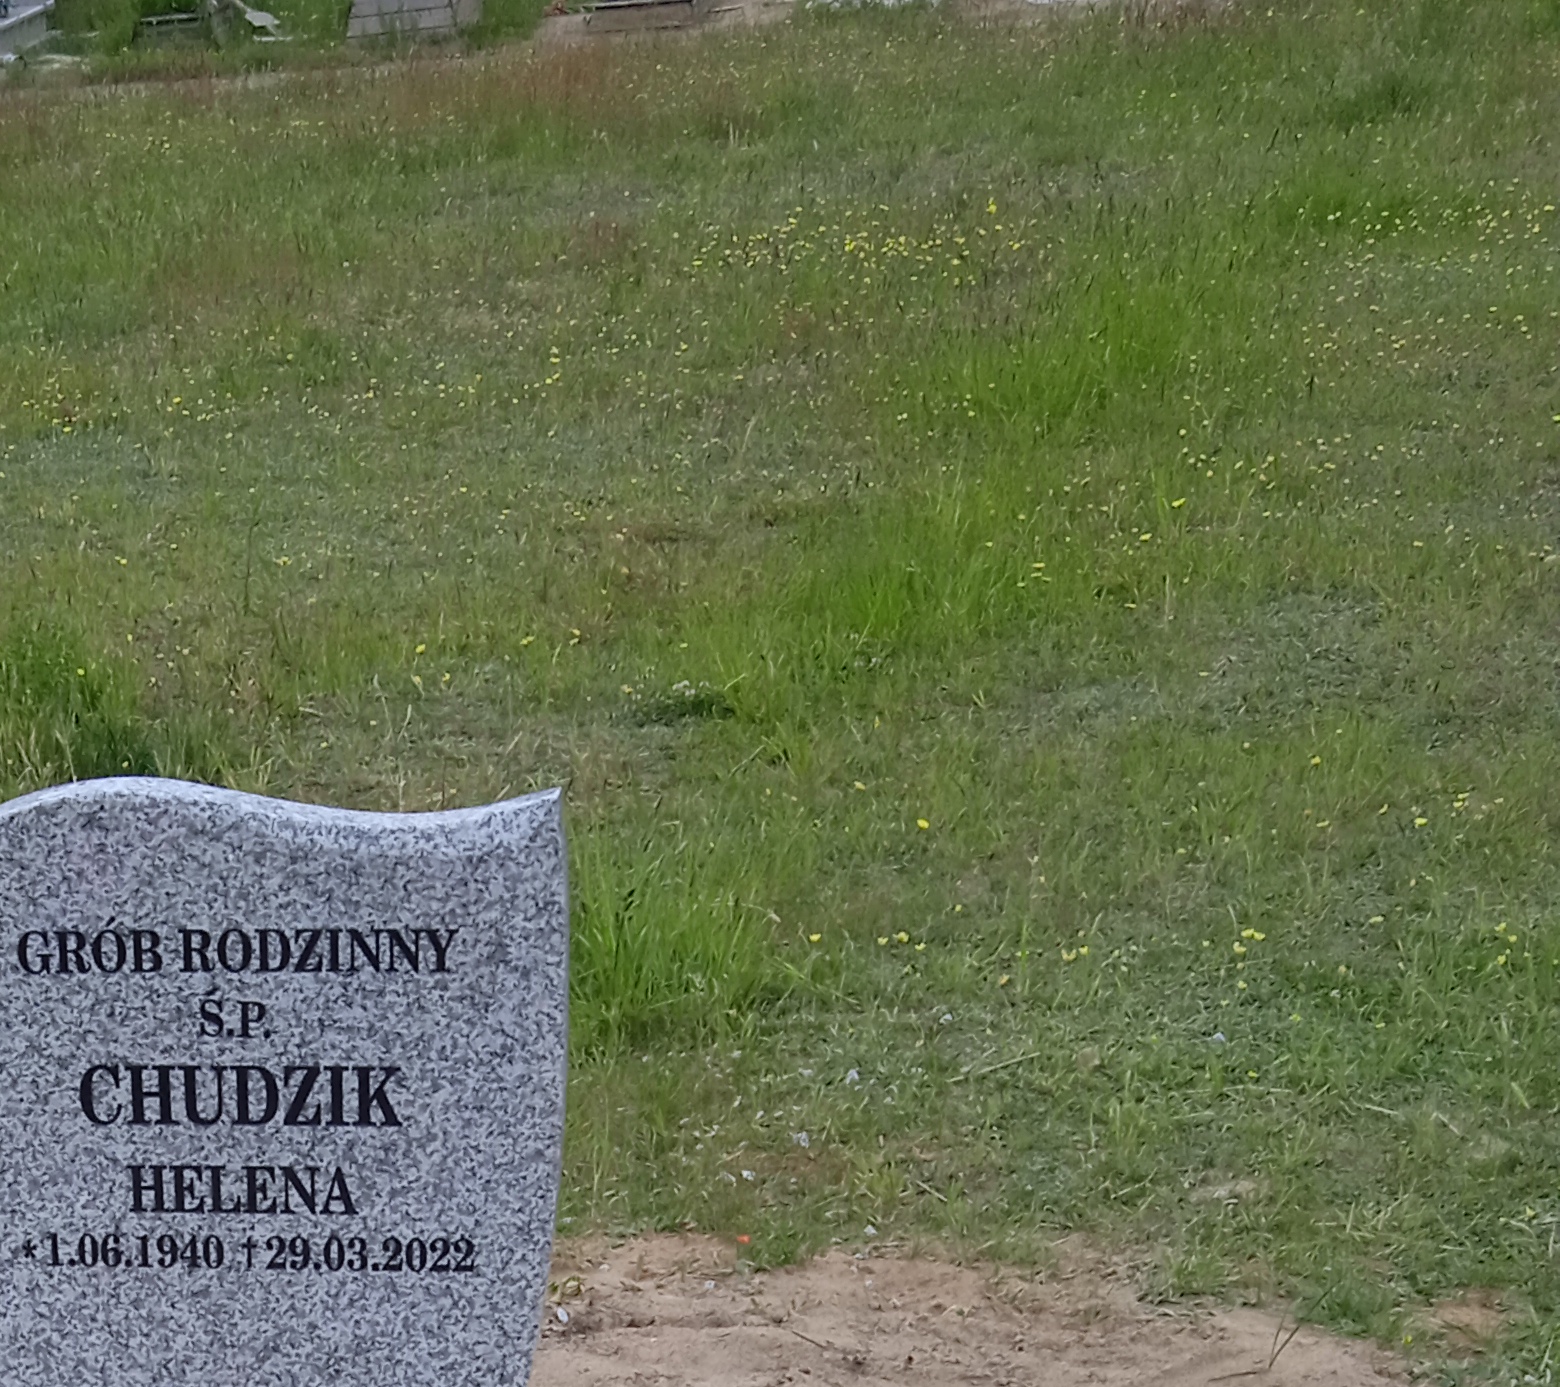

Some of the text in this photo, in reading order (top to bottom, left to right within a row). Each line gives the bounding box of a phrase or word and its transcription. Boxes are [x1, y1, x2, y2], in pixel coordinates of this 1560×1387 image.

[16, 917, 458, 975] GRÓB RODZINNY
[79, 1065, 402, 1127] CHUDZIK
[129, 1165, 358, 1215] HELENA
